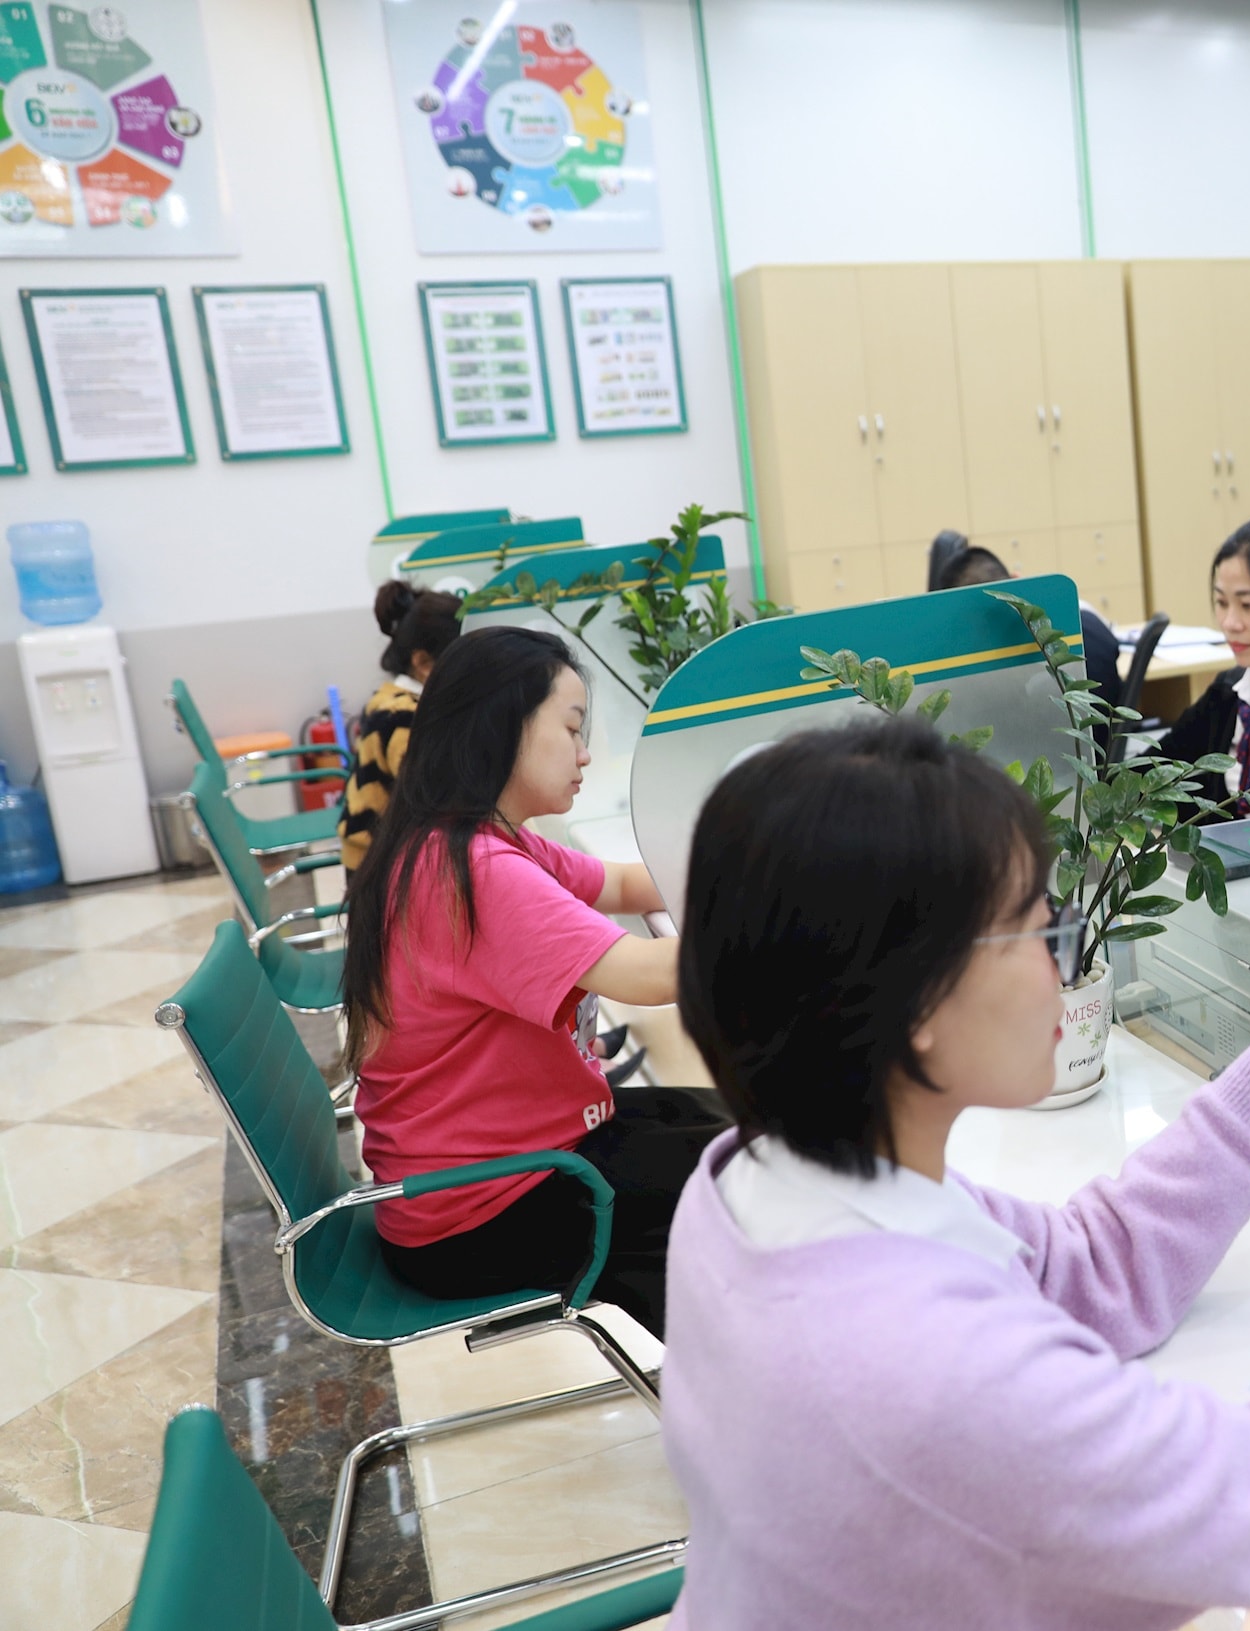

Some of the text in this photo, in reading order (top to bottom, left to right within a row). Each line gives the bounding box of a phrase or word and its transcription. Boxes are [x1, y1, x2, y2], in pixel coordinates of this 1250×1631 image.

[25, 99, 46, 127] 6
[499, 108, 514, 134] 7
[1065, 999, 1102, 1025] MISS
